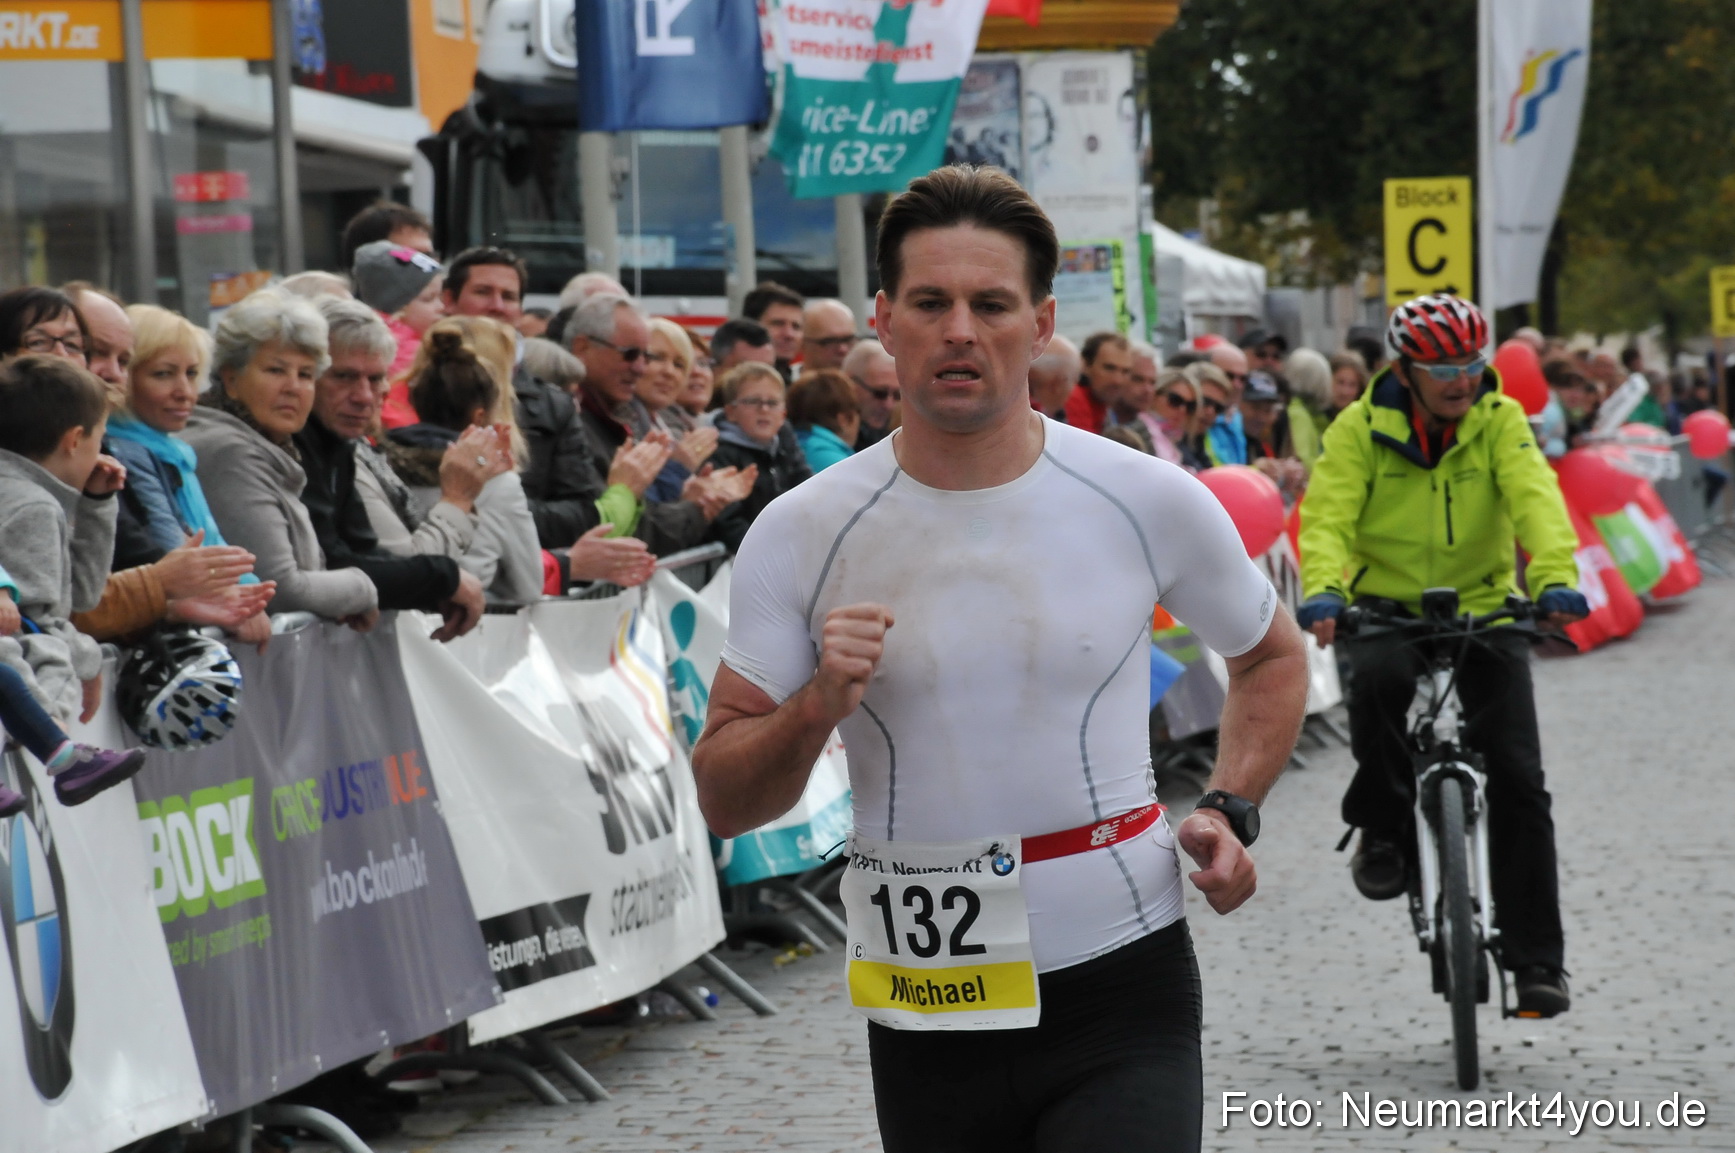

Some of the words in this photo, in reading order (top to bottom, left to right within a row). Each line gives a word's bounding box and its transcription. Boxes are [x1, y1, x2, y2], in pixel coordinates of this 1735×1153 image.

[1395, 185, 1457, 208] Block
[1407, 217, 1447, 277] C
[139, 793, 262, 908] BOCK
[870, 883, 987, 959] 132
[889, 974, 986, 1007] Michael
